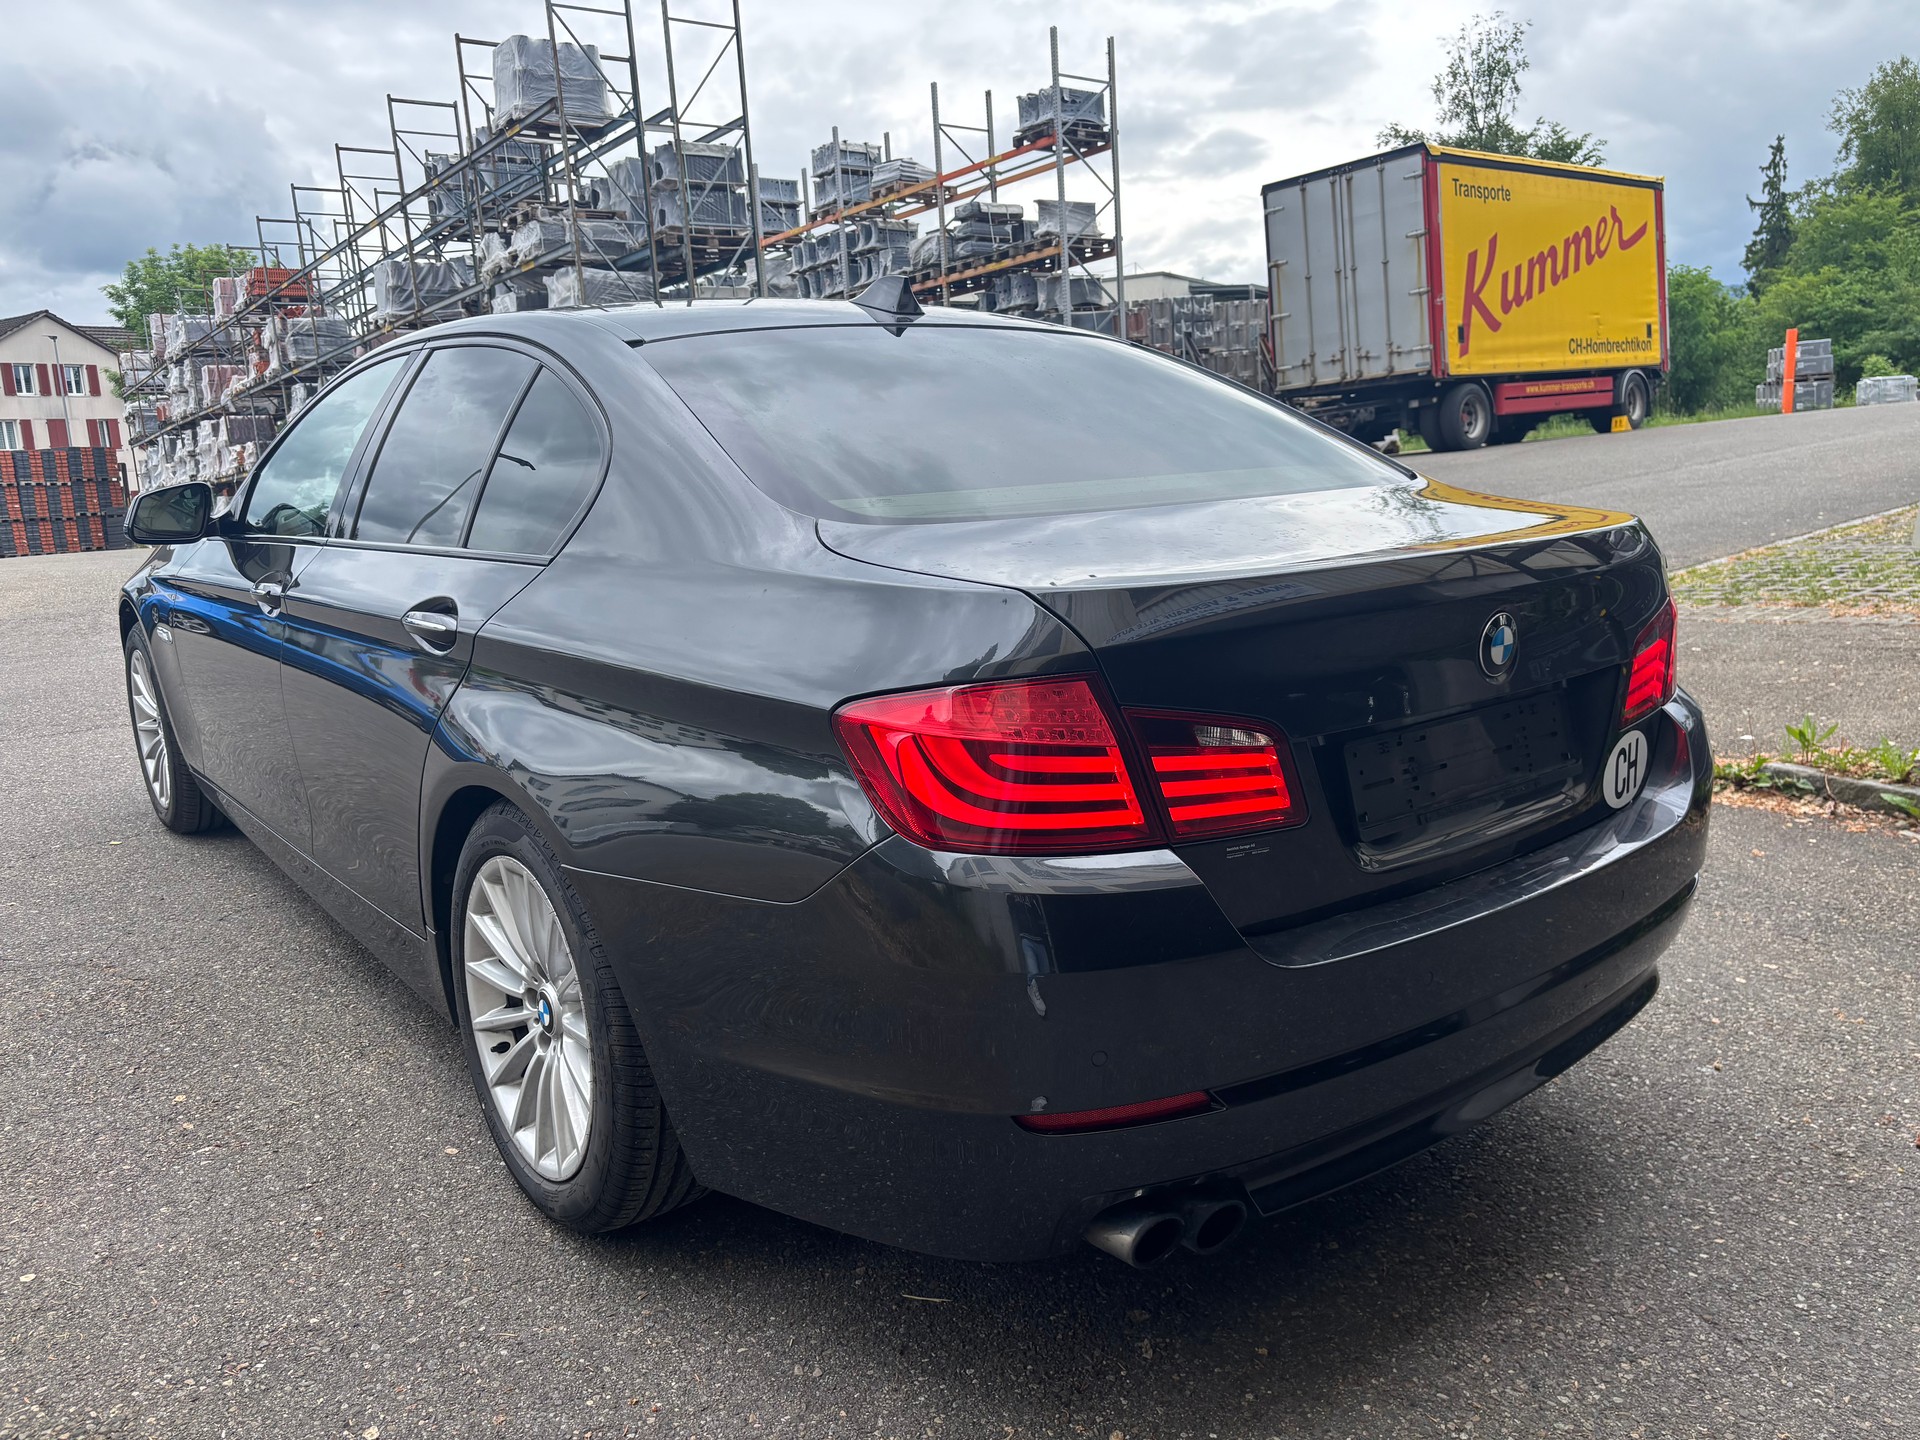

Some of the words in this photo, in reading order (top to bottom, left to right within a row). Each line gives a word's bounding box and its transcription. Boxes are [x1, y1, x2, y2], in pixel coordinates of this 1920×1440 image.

[1452, 178, 1511, 204] Transporte
[1459, 205, 1648, 359] Kummer
[1568, 337, 1652, 354] CH-Hombrechtikon
[1487, 614, 1517, 637] BMW
[1615, 737, 1639, 799] CH
